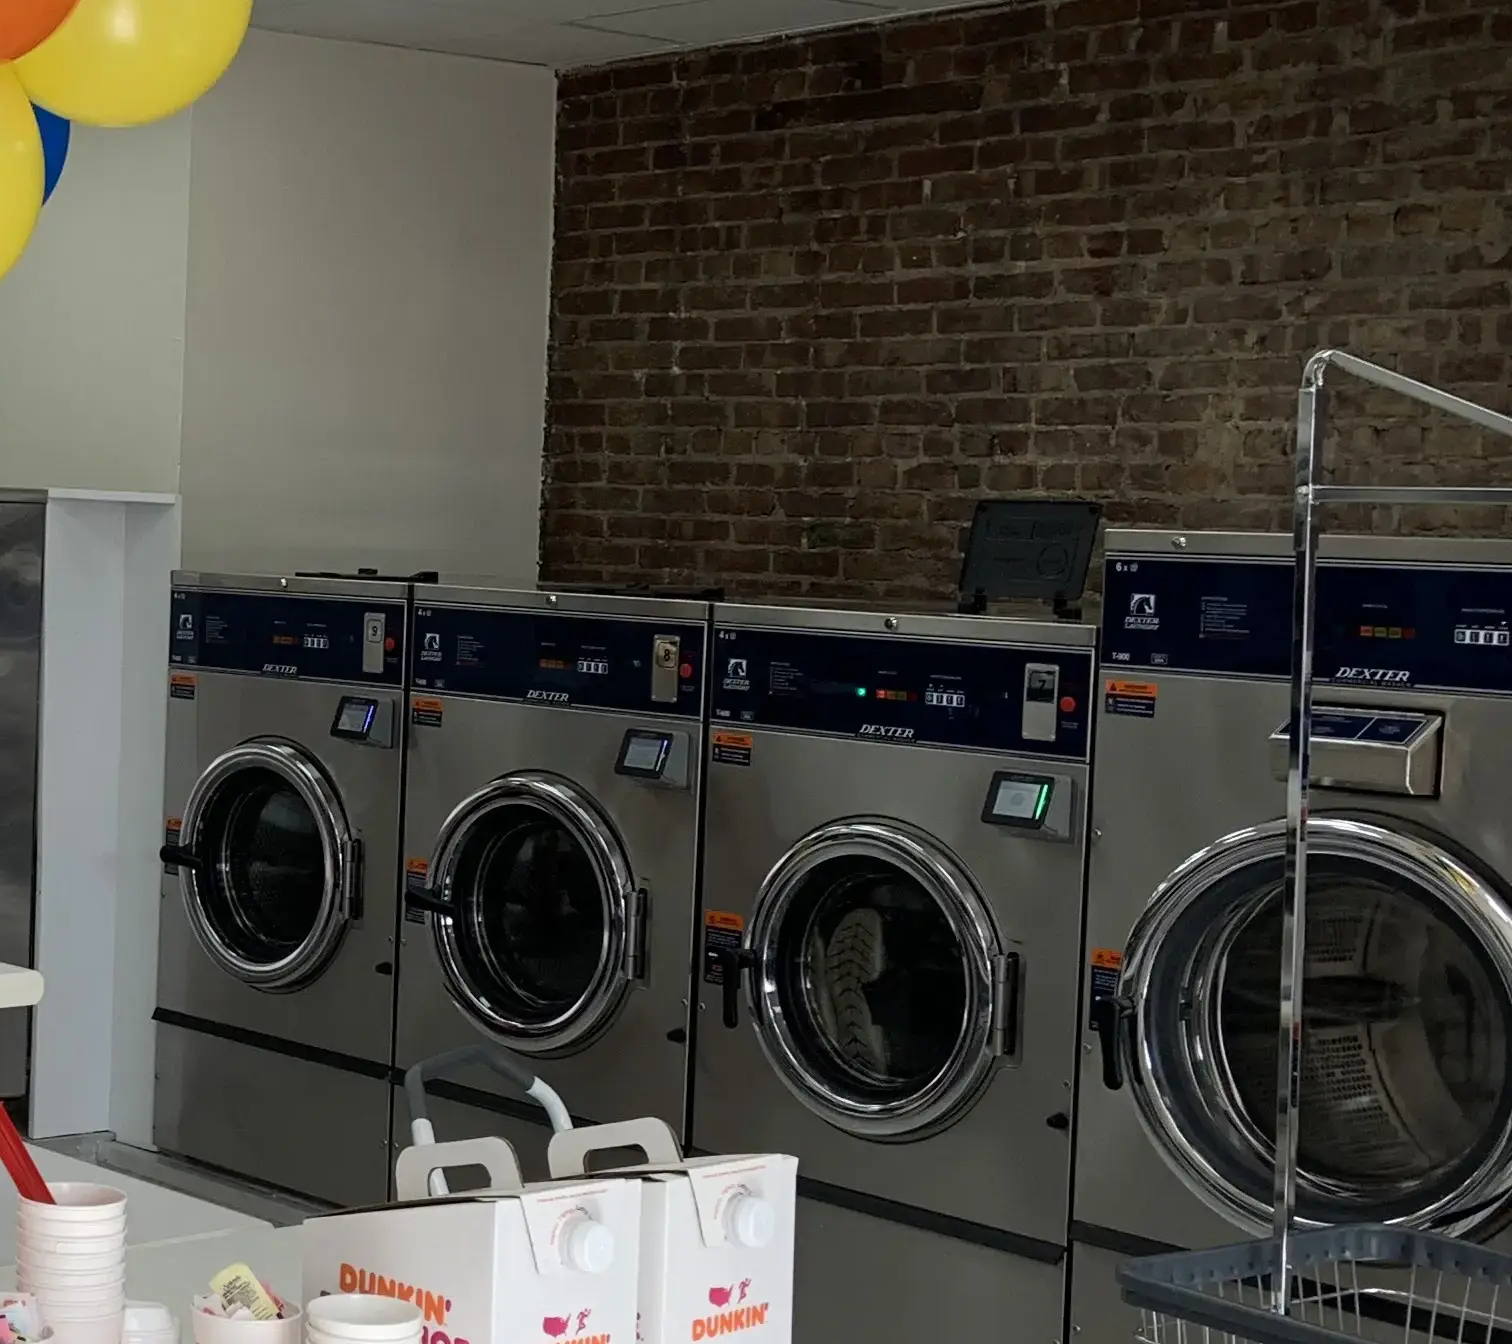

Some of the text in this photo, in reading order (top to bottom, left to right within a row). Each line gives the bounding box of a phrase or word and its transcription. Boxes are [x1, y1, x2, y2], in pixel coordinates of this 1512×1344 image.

[262, 662, 298, 675] DEXTER
[1335, 666, 1410, 683] DEXTER
[527, 688, 570, 702] DEXTER
[858, 722, 915, 739] DEXTER
[339, 1262, 452, 1326] DUNKIN'
[691, 1302, 769, 1342] DUNKIN'
